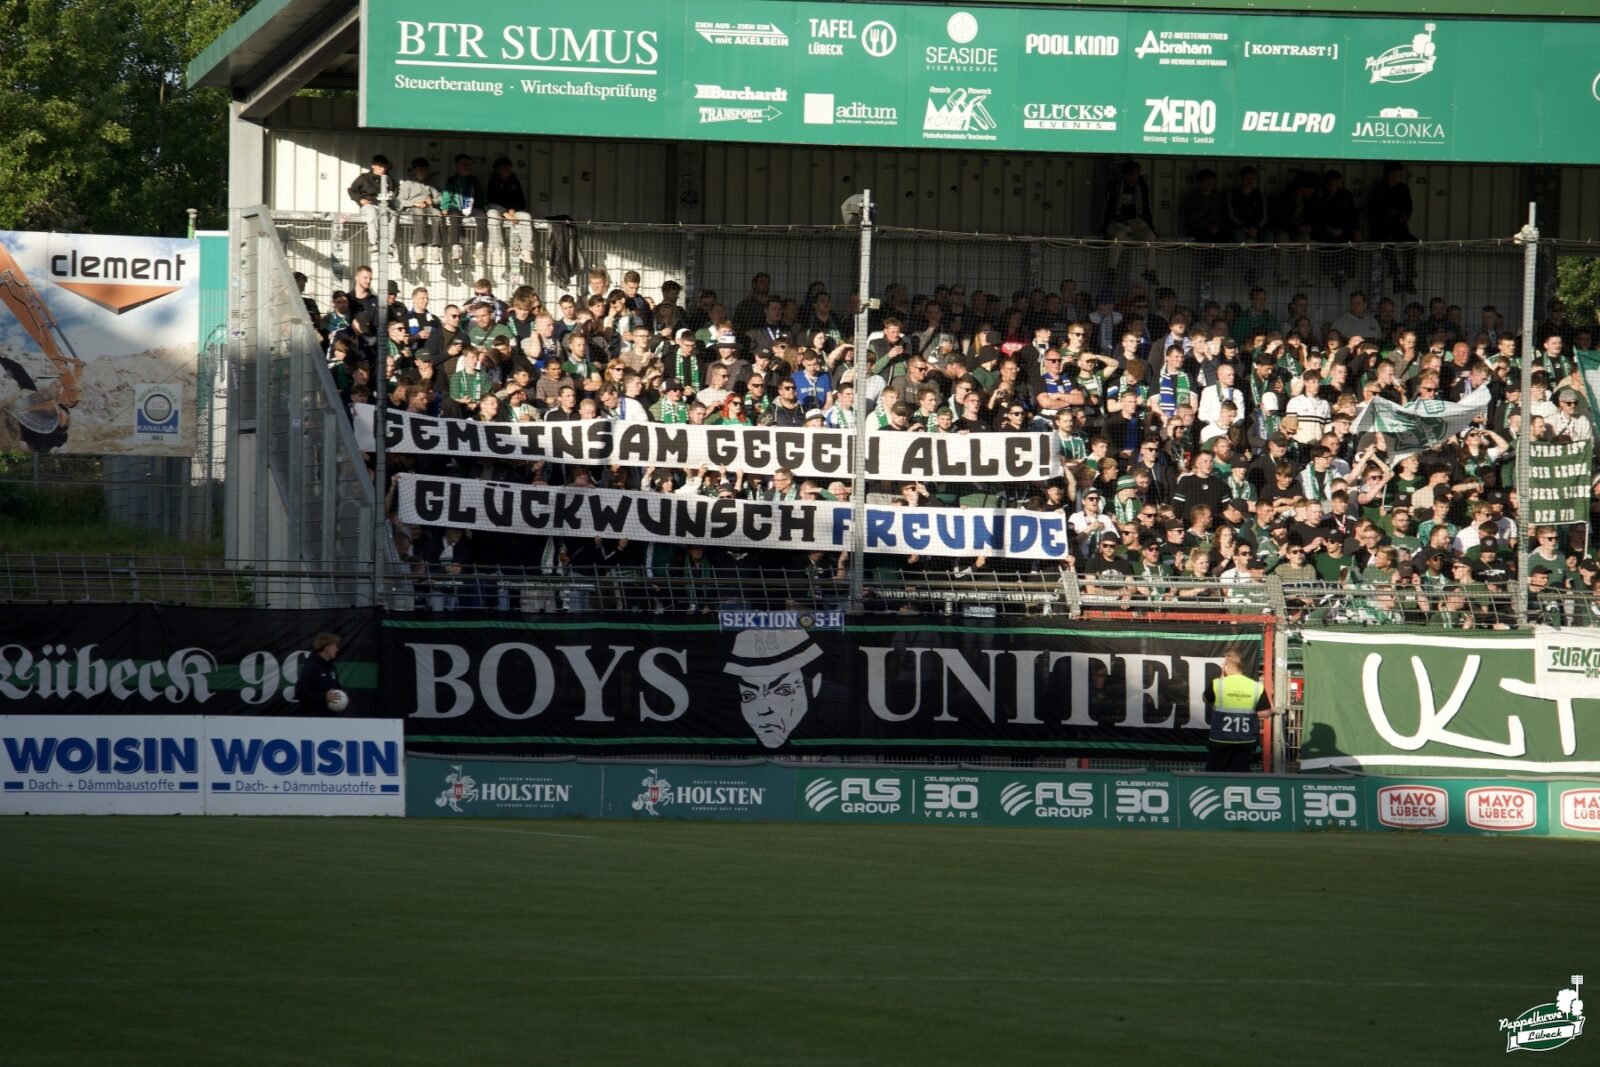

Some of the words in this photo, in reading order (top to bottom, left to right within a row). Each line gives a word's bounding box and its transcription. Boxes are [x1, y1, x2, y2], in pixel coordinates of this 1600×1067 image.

[809, 18, 857, 39] TAFEL
[396, 20, 487, 58] BTR
[501, 25, 659, 65] SUMUS
[715, 36, 732, 45] mit
[734, 36, 789, 47] AKELBEIN
[808, 43, 844, 56] LÜBECK
[1134, 30, 1213, 60] Abraham
[925, 46, 998, 65] SEASIDE
[394, 74, 503, 96] Steuerberatung
[520, 79, 657, 102] Wirtschaftsprüfung
[711, 85, 788, 102] Burchardt
[836, 101, 898, 120] aditum
[1039, 121, 1102, 130] EVENTS
[1242, 111, 1336, 134] DELLPRO
[1351, 121, 1446, 138] JABLONKA
[51, 250, 186, 281] clement
[374, 409, 688, 463] GEMEINSAM
[902, 434, 1051, 477] ALLE!
[1530, 444, 1563, 458] LTRAS
[1528, 465, 1551, 479] SER
[1528, 487, 1559, 501] SERE
[415, 480, 817, 542] GLÜCKWUNSCH
[832, 506, 1067, 557] FREUNDE
[722, 612, 797, 628] SEKTION
[404, 641, 691, 722] BOYS
[1222, 716, 1250, 733] 215
[3, 737, 198, 774] WOISIN
[211, 738, 399, 776] WOISIN
[28, 779, 64, 791] Dach-
[78, 778, 175, 792] Dämmbaustoffe
[235, 780, 271, 793] Dach-
[284, 780, 376, 794] Dämmbaustoffe
[481, 783, 569, 802] HOLSTEN
[841, 778, 901, 801] FLS
[677, 786, 763, 805] HOLSTEN
[924, 784, 979, 810] 30
[1035, 782, 1094, 806] FLS
[1116, 788, 1170, 814] 30
[1223, 786, 1282, 810] FLS
[1389, 792, 1436, 806] MAYO
[1478, 794, 1525, 808] MAYO
[841, 802, 901, 814] GROUP
[1035, 806, 1093, 818] GROUP
[1303, 792, 1357, 818] 30
[1390, 806, 1437, 818] LÜBECK
[1478, 808, 1525, 819] LÜBECK
[924, 811, 979, 819] YEARS
[1116, 815, 1170, 823] YEARS
[1223, 811, 1282, 822] GROUP
[1304, 818, 1358, 827] YEARS
